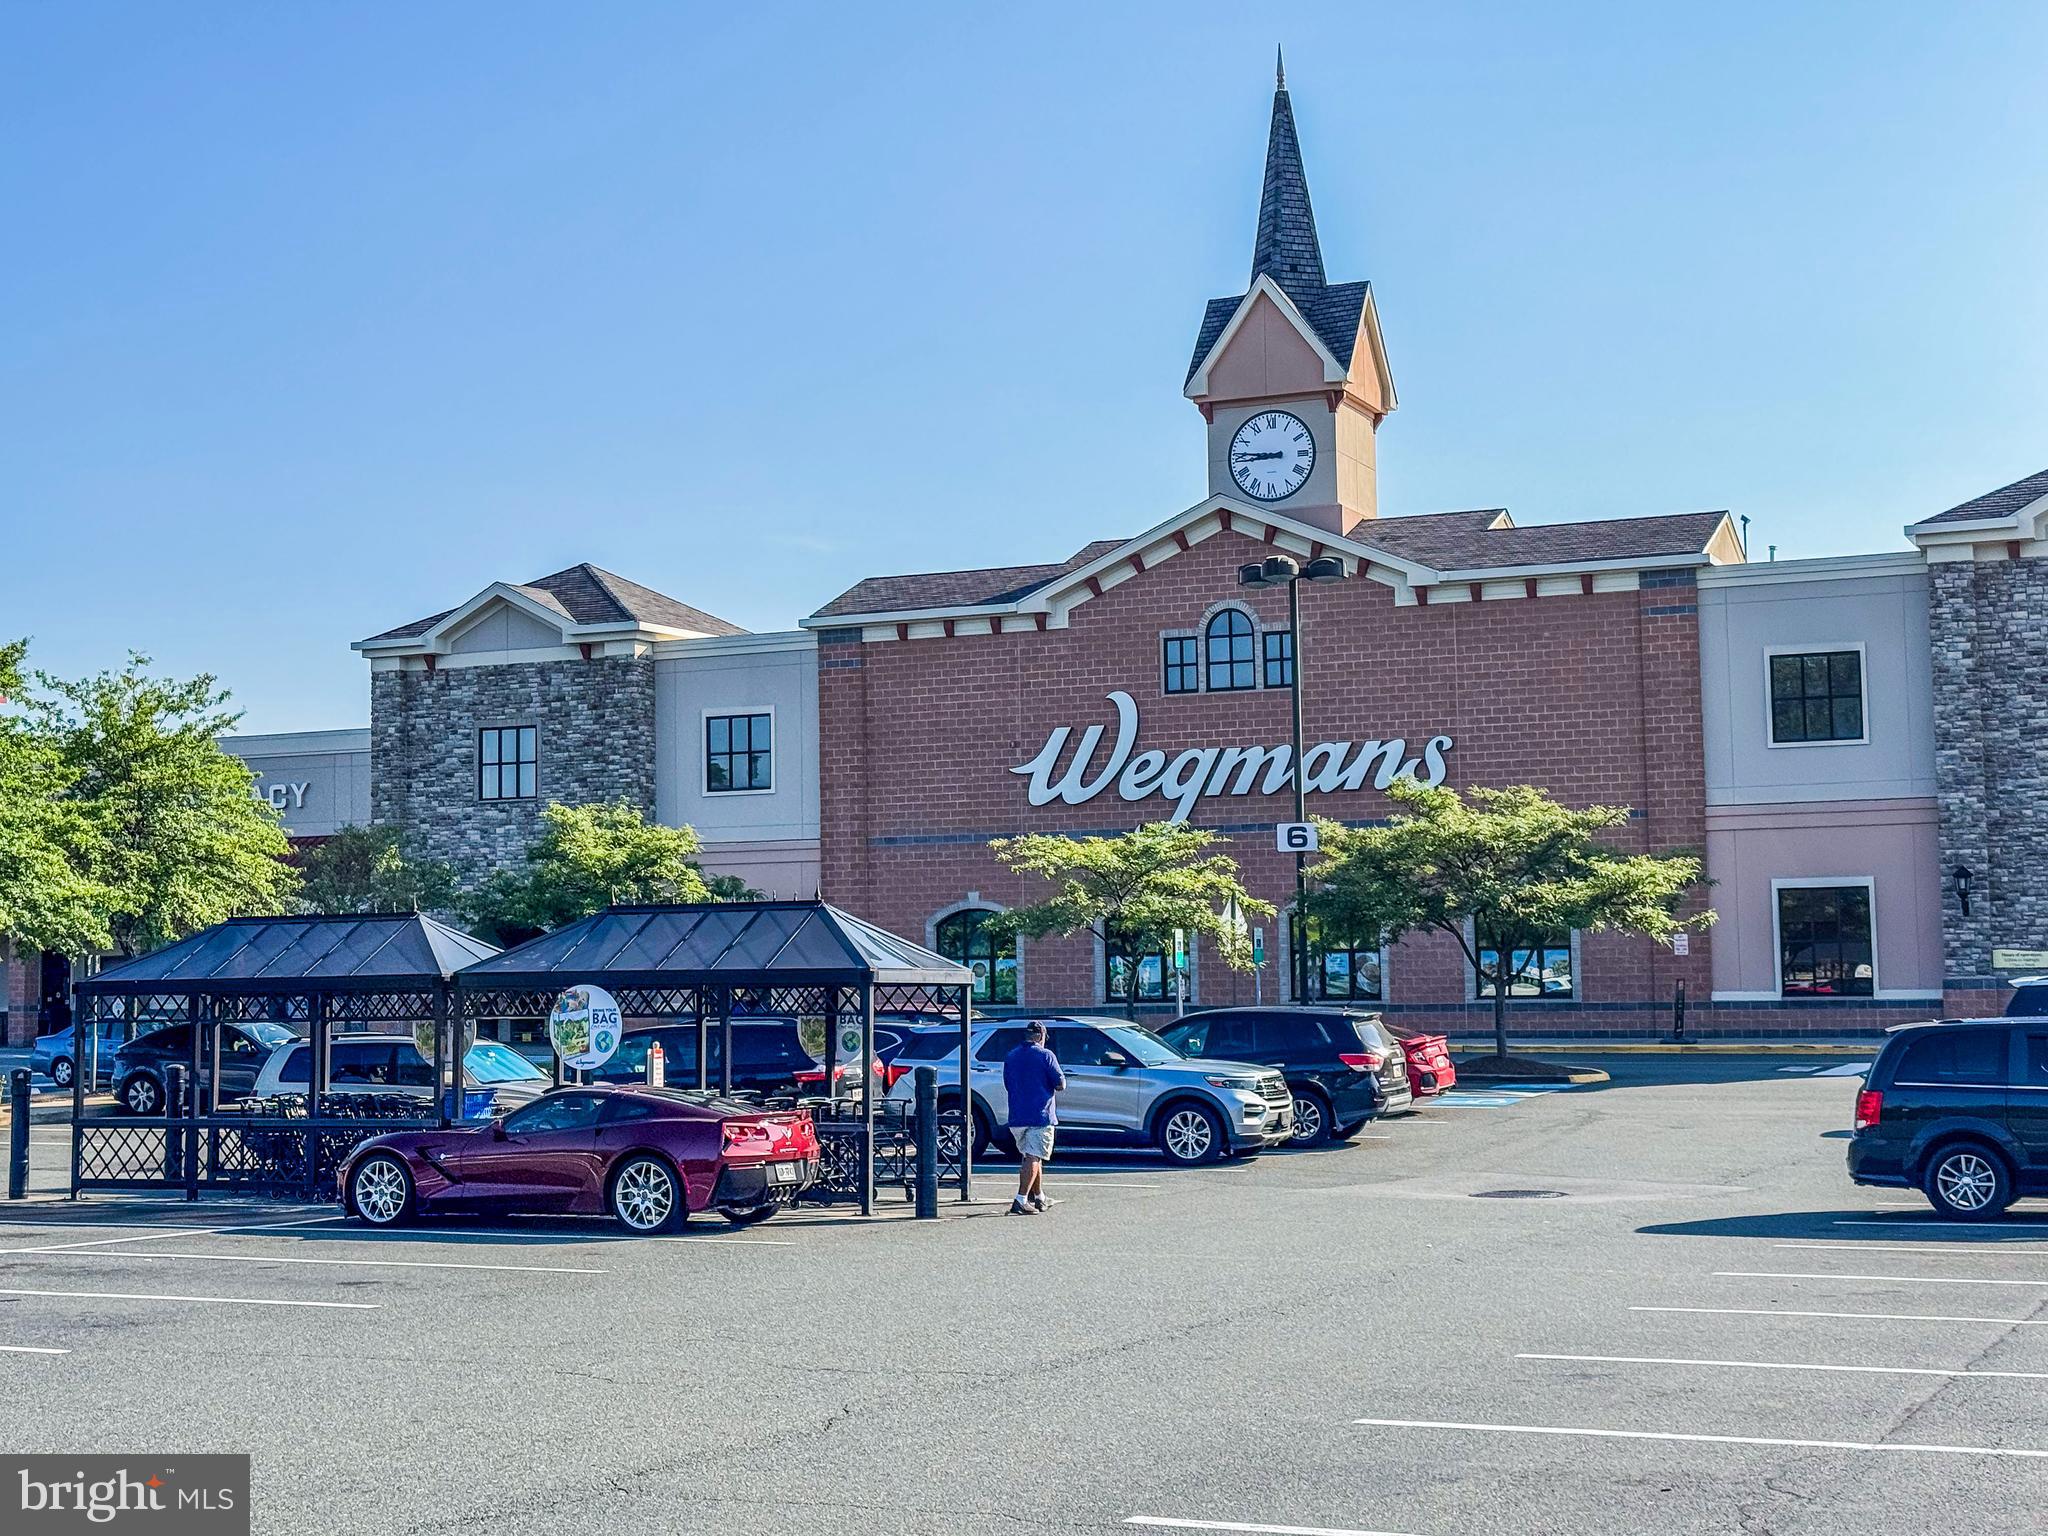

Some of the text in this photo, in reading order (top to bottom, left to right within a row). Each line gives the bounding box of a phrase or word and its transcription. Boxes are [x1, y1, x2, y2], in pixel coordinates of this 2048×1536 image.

[1009, 690, 1454, 833] Wegmans
[1287, 826, 1308, 848] 6
[592, 1012, 618, 1024] BAG
